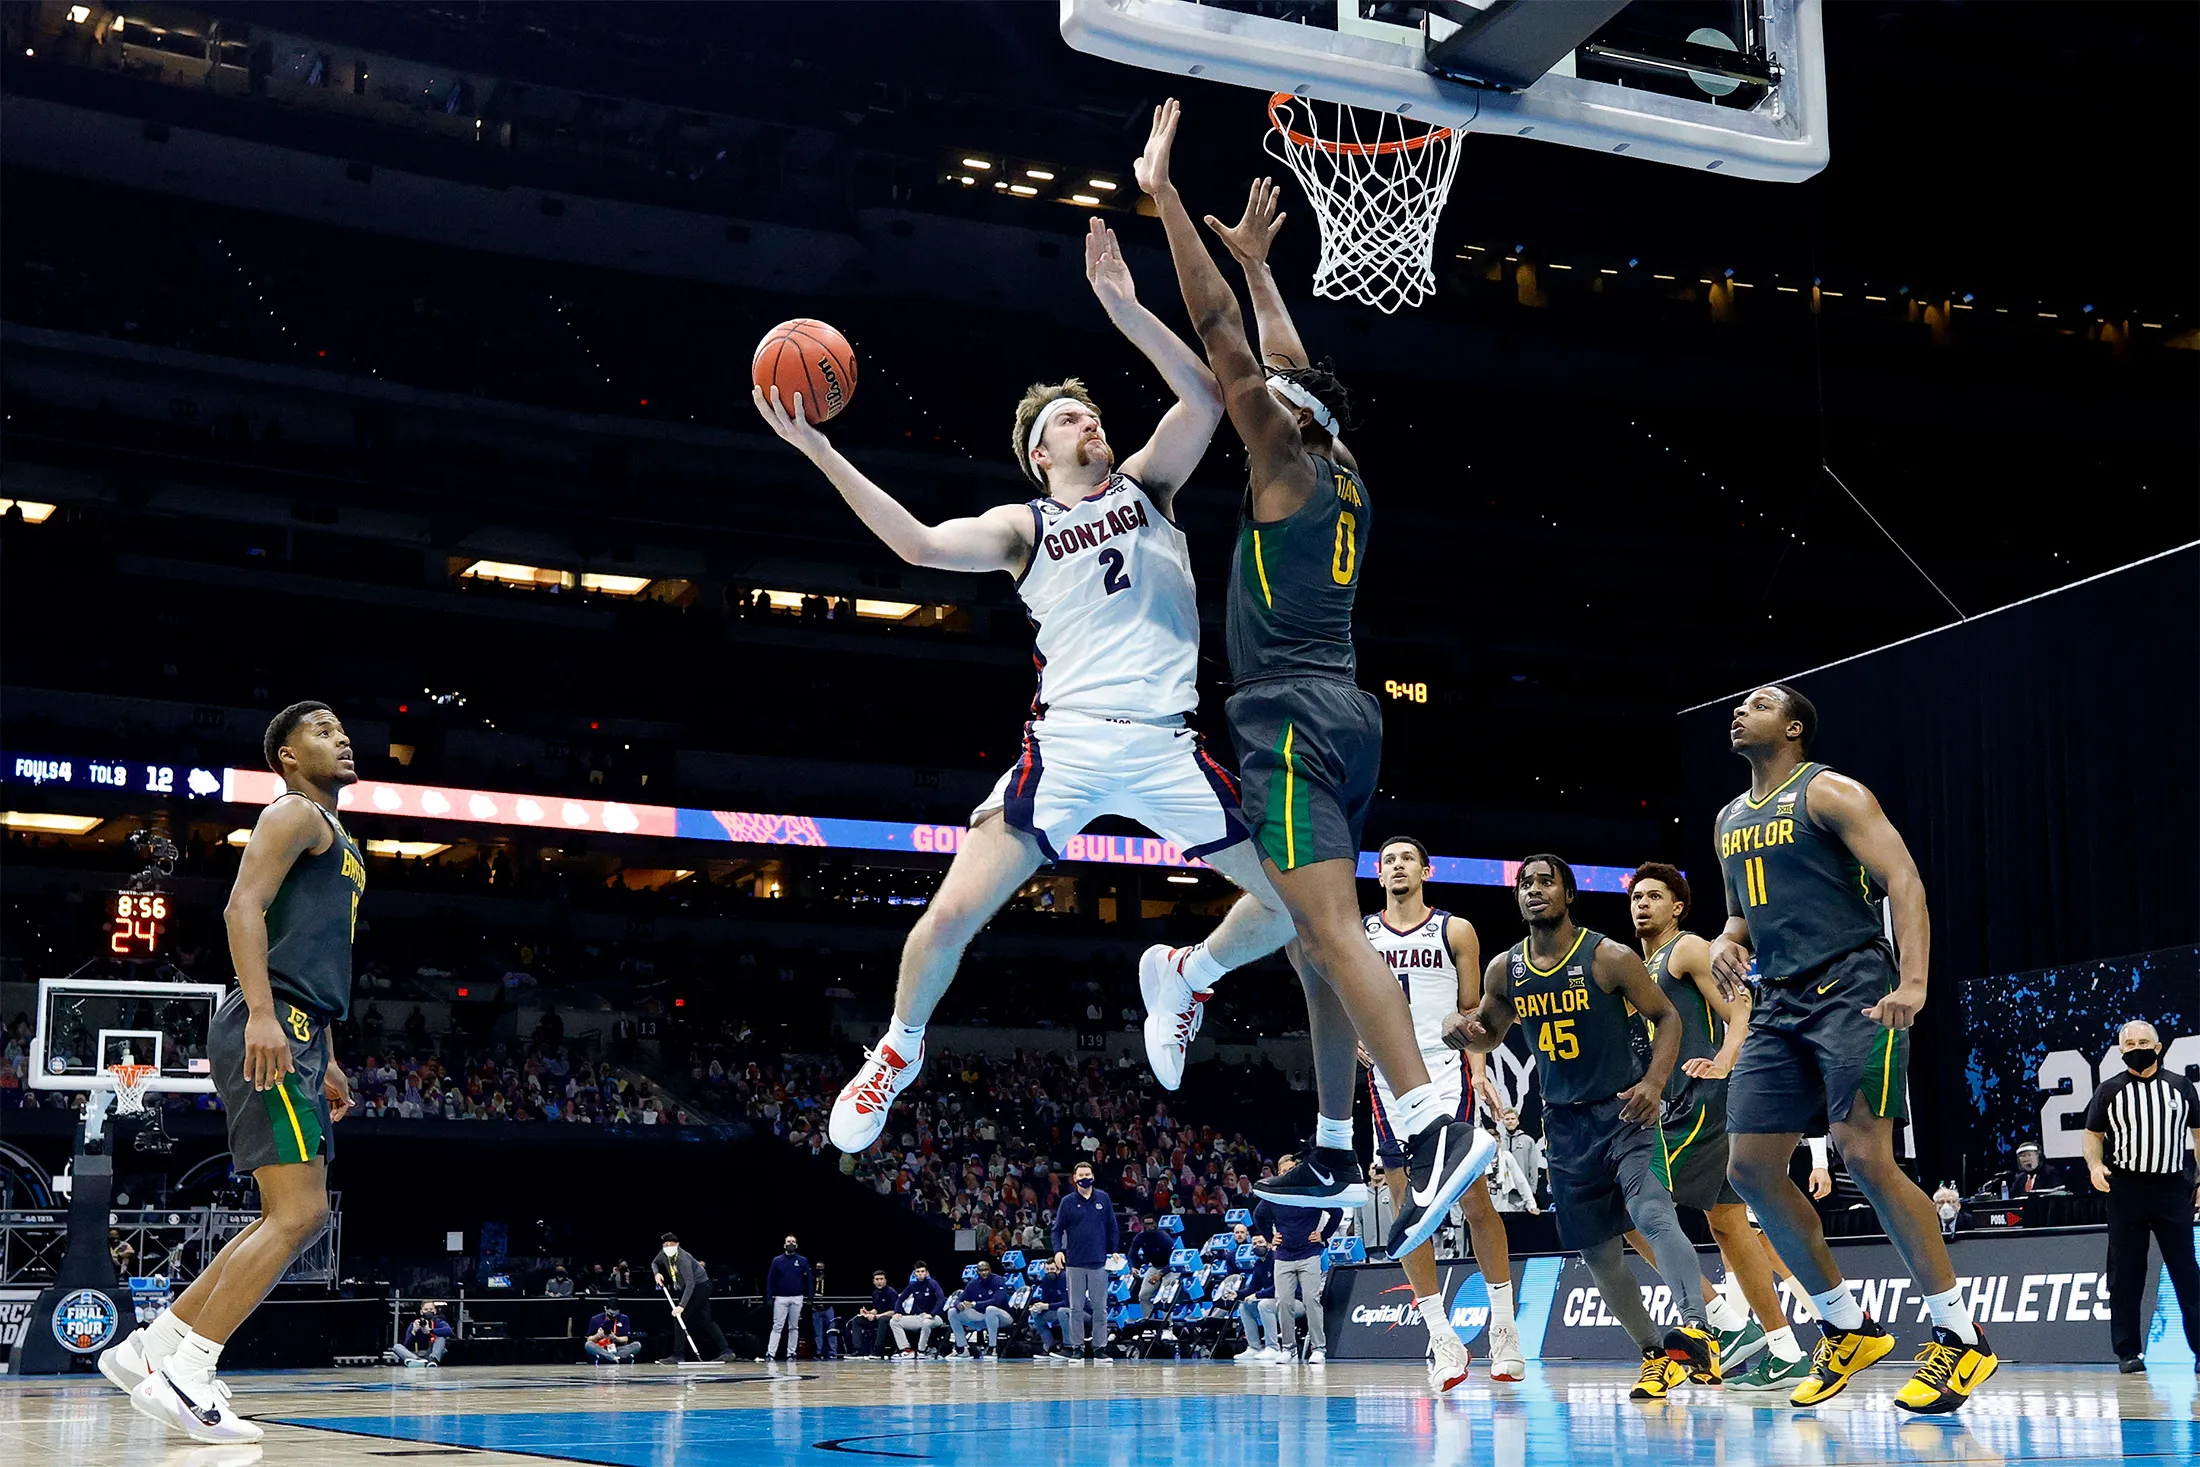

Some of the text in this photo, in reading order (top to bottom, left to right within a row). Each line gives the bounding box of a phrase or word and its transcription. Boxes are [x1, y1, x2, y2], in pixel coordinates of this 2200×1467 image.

[1044, 500, 1149, 561] GONZAGA
[1332, 511, 1356, 585] 0
[1099, 548, 1131, 595] 2
[1385, 680, 1427, 703] 9:48
[146, 766, 174, 792] 12
[1722, 819, 1794, 859] BAYLOR
[1745, 856, 1768, 907] 11
[118, 895, 166, 919] 8:56
[112, 917, 155, 952] 24
[1514, 989, 1590, 1018] BAYLOR
[1081, 1034, 1103, 1046] 139
[1538, 1019, 1580, 1061] 45
[67, 1307, 104, 1320] FINAL
[1450, 1306, 1490, 1327] NCAA
[67, 1321, 103, 1336] FOUR
